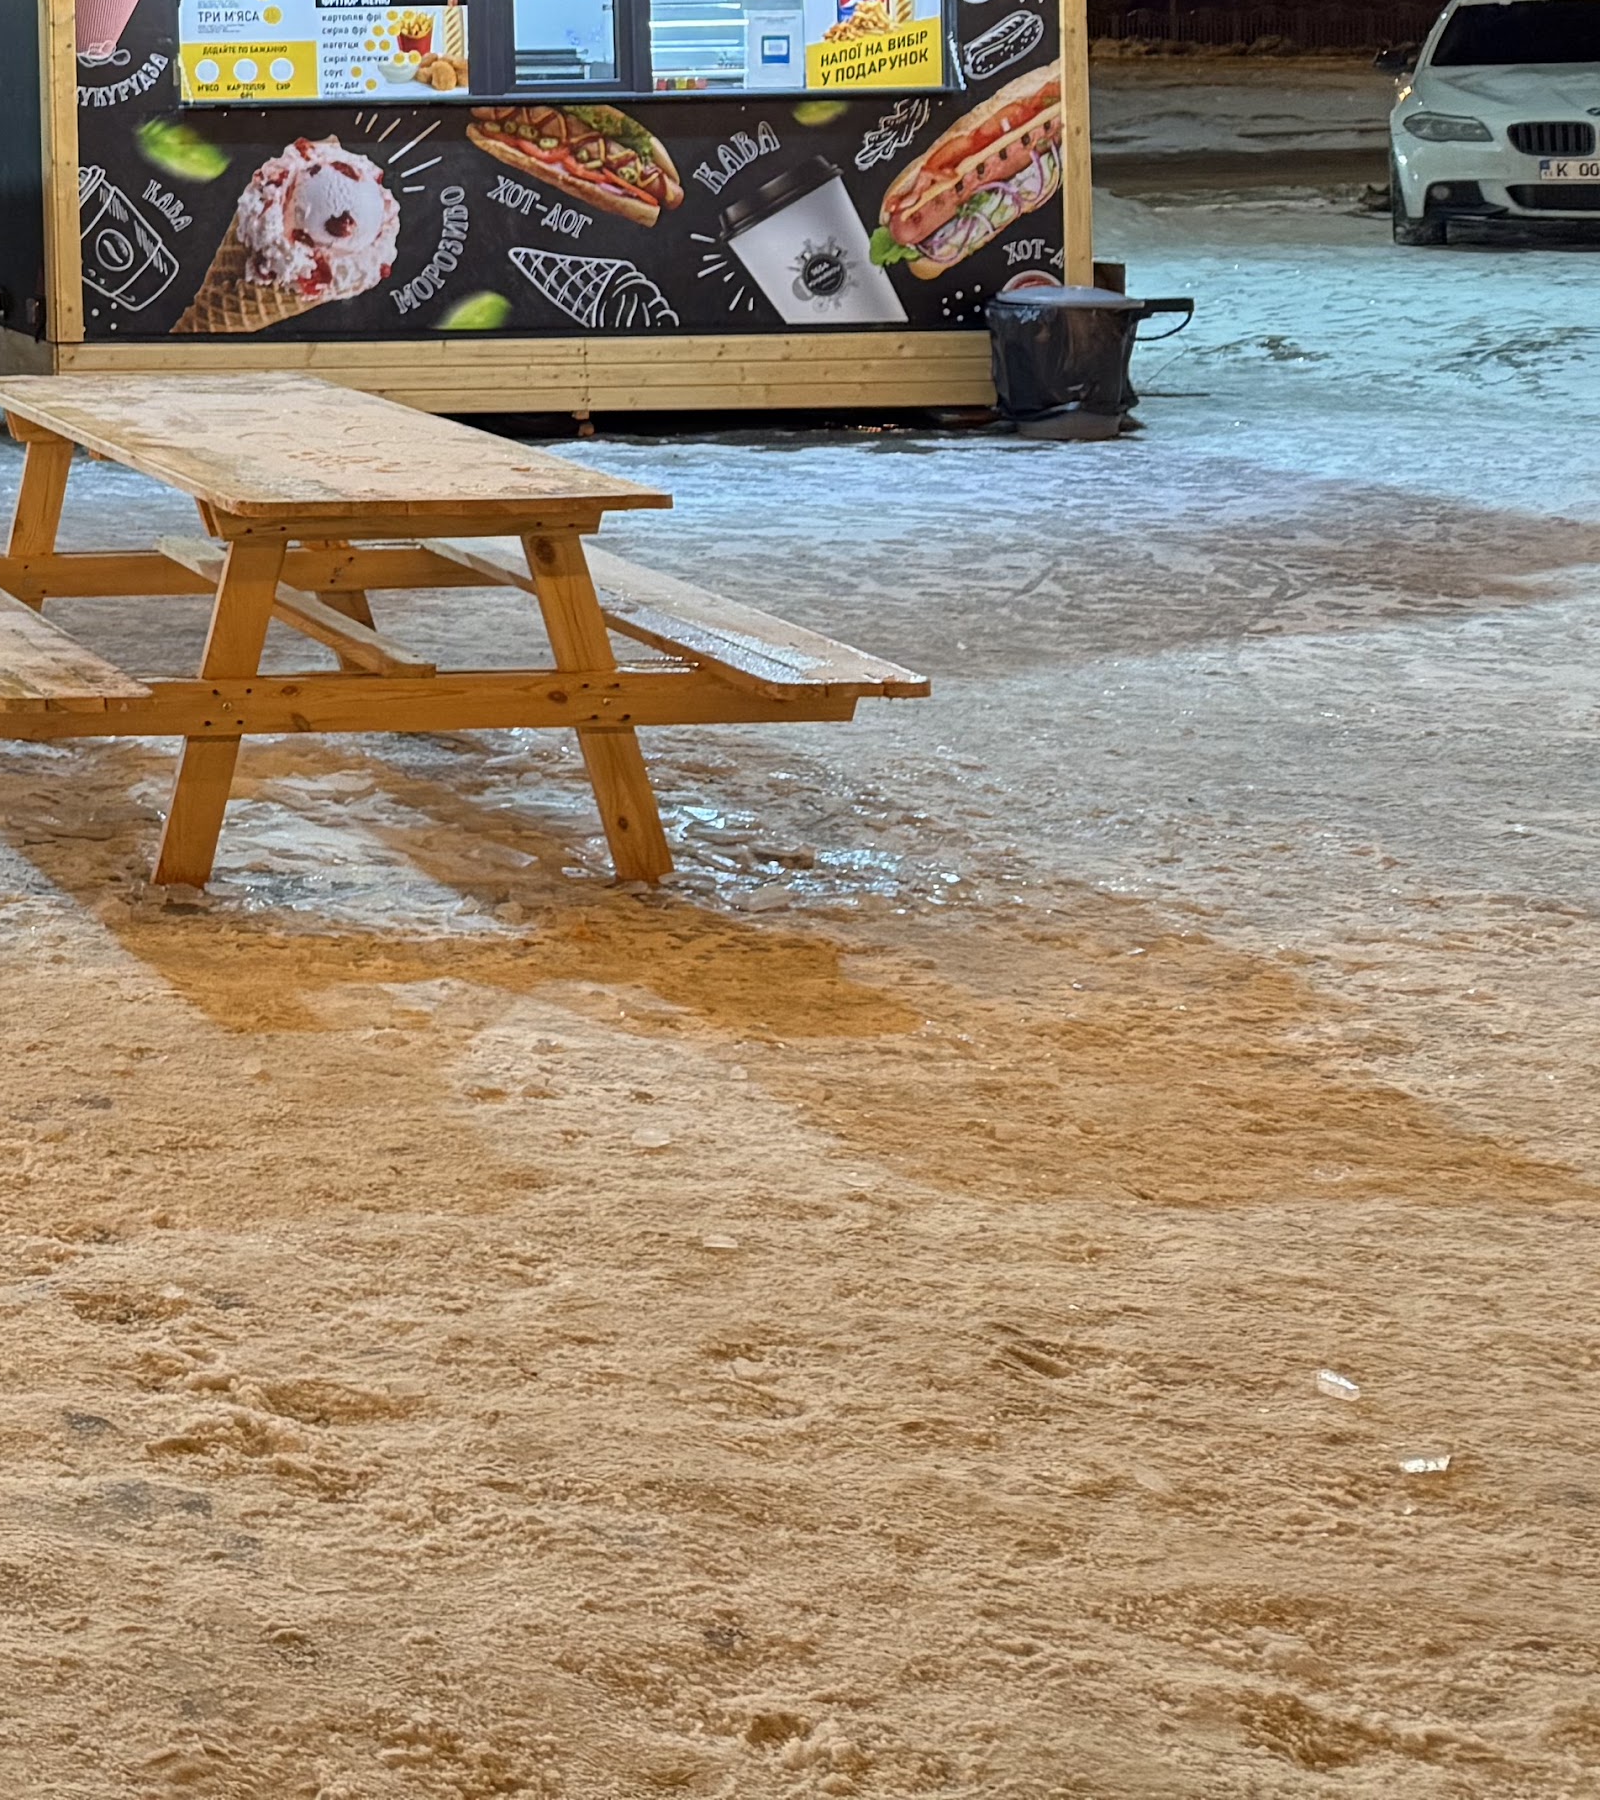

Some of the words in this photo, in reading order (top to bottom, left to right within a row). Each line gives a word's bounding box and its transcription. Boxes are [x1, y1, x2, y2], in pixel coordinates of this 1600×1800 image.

[197, 11, 221, 23] ТРИ
[224, 10, 260, 22] М'ЯСА
[351, 25, 367, 35] фрі
[366, 12, 382, 22] фрі
[820, 42, 862, 67] НАПОЇ
[865, 39, 883, 57] НА
[888, 30, 928, 52] ВИБІР
[821, 71, 831, 86] У
[835, 48, 929, 83] ПОДАРУНОК
[76, 53, 169, 107] УКУРУДЗА
[324, 69, 343, 78] соус
[693, 120, 781, 195] КАВА
[141, 178, 193, 233] КАВА
[486, 175, 593, 239] ХОТ-ДОГ
[389, 185, 470, 314] МОРОЗИВО
